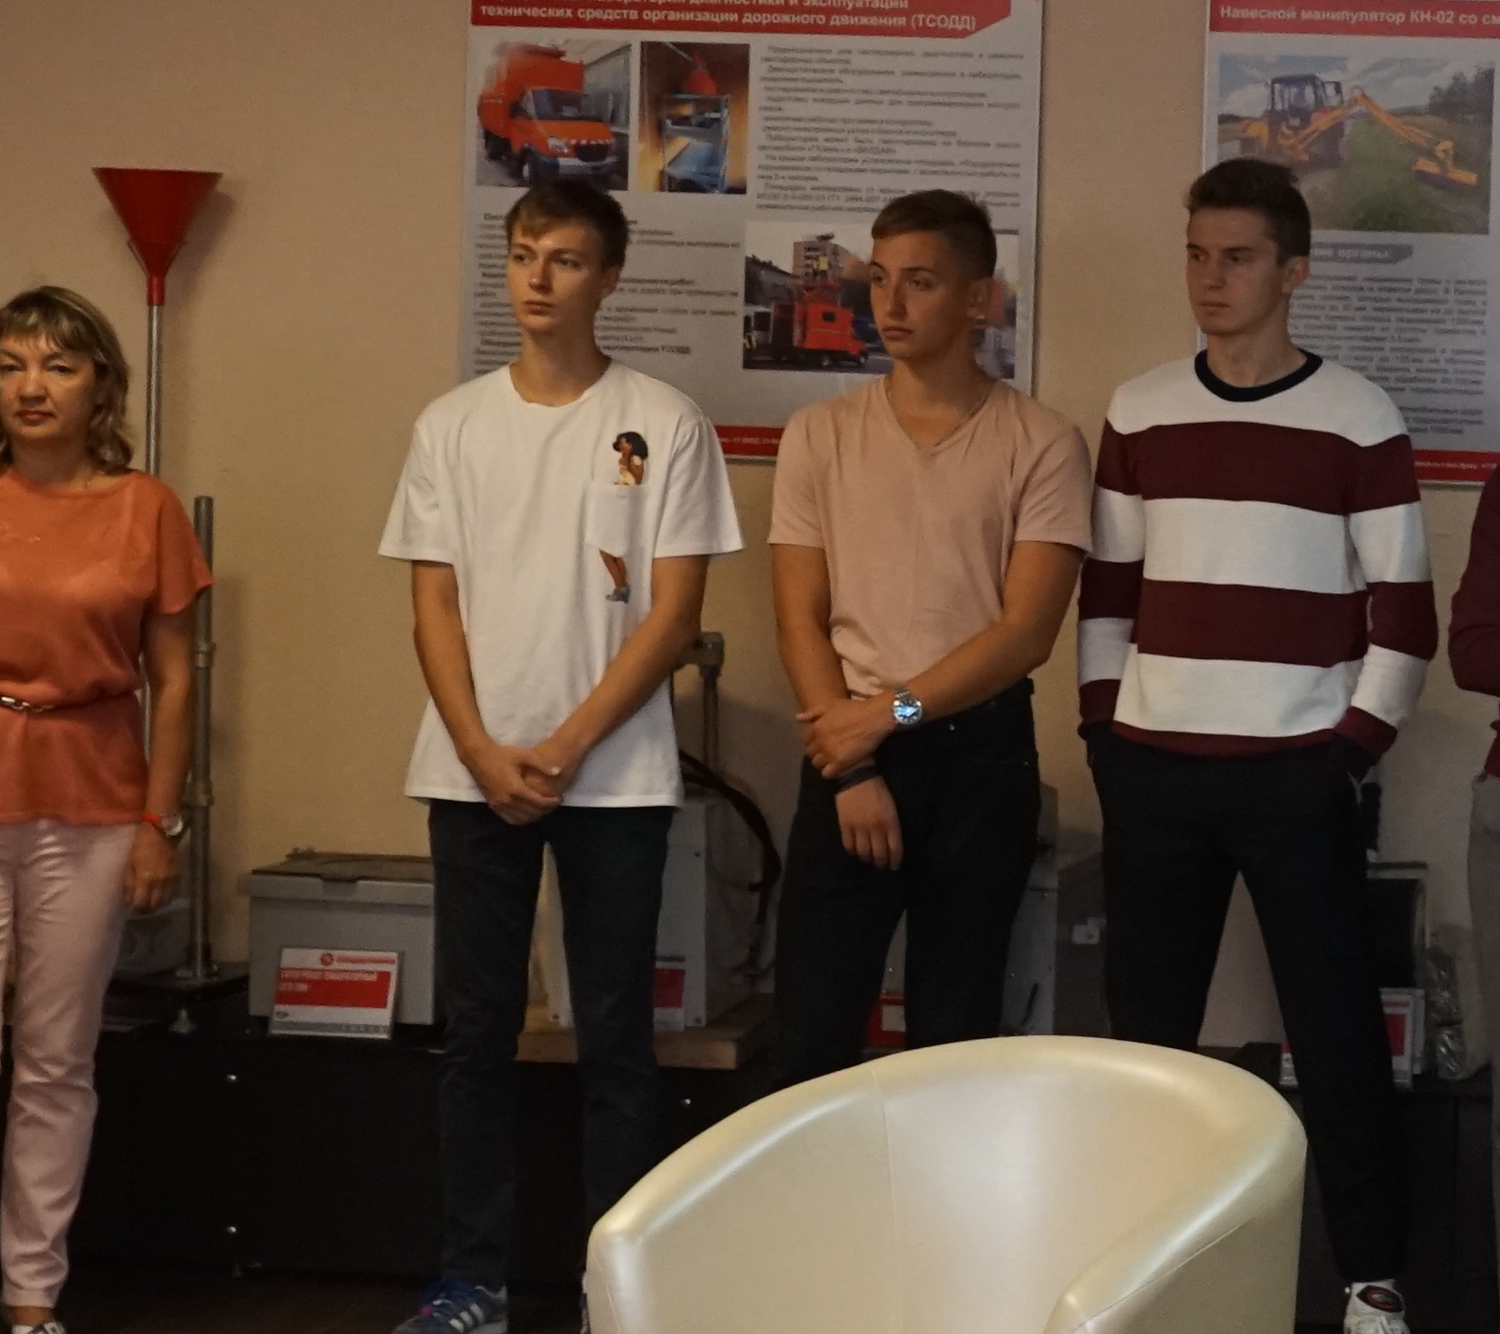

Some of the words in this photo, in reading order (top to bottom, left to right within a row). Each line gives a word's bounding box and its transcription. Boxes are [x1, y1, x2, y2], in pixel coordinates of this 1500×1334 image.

[480, 5, 573, 19] технических
[577, 7, 639, 22] средств
[643, 10, 739, 24] организации
[742, 12, 826, 26] дорожного
[830, 15, 907, 27] движения
[911, 14, 976, 31] (ТСОДД)
[1220, 4, 1297, 21] Навесной
[1301, 9, 1405, 26] манипулятор
[1410, 10, 1454, 26] КН-02
[1459, 14, 1478, 26] со
